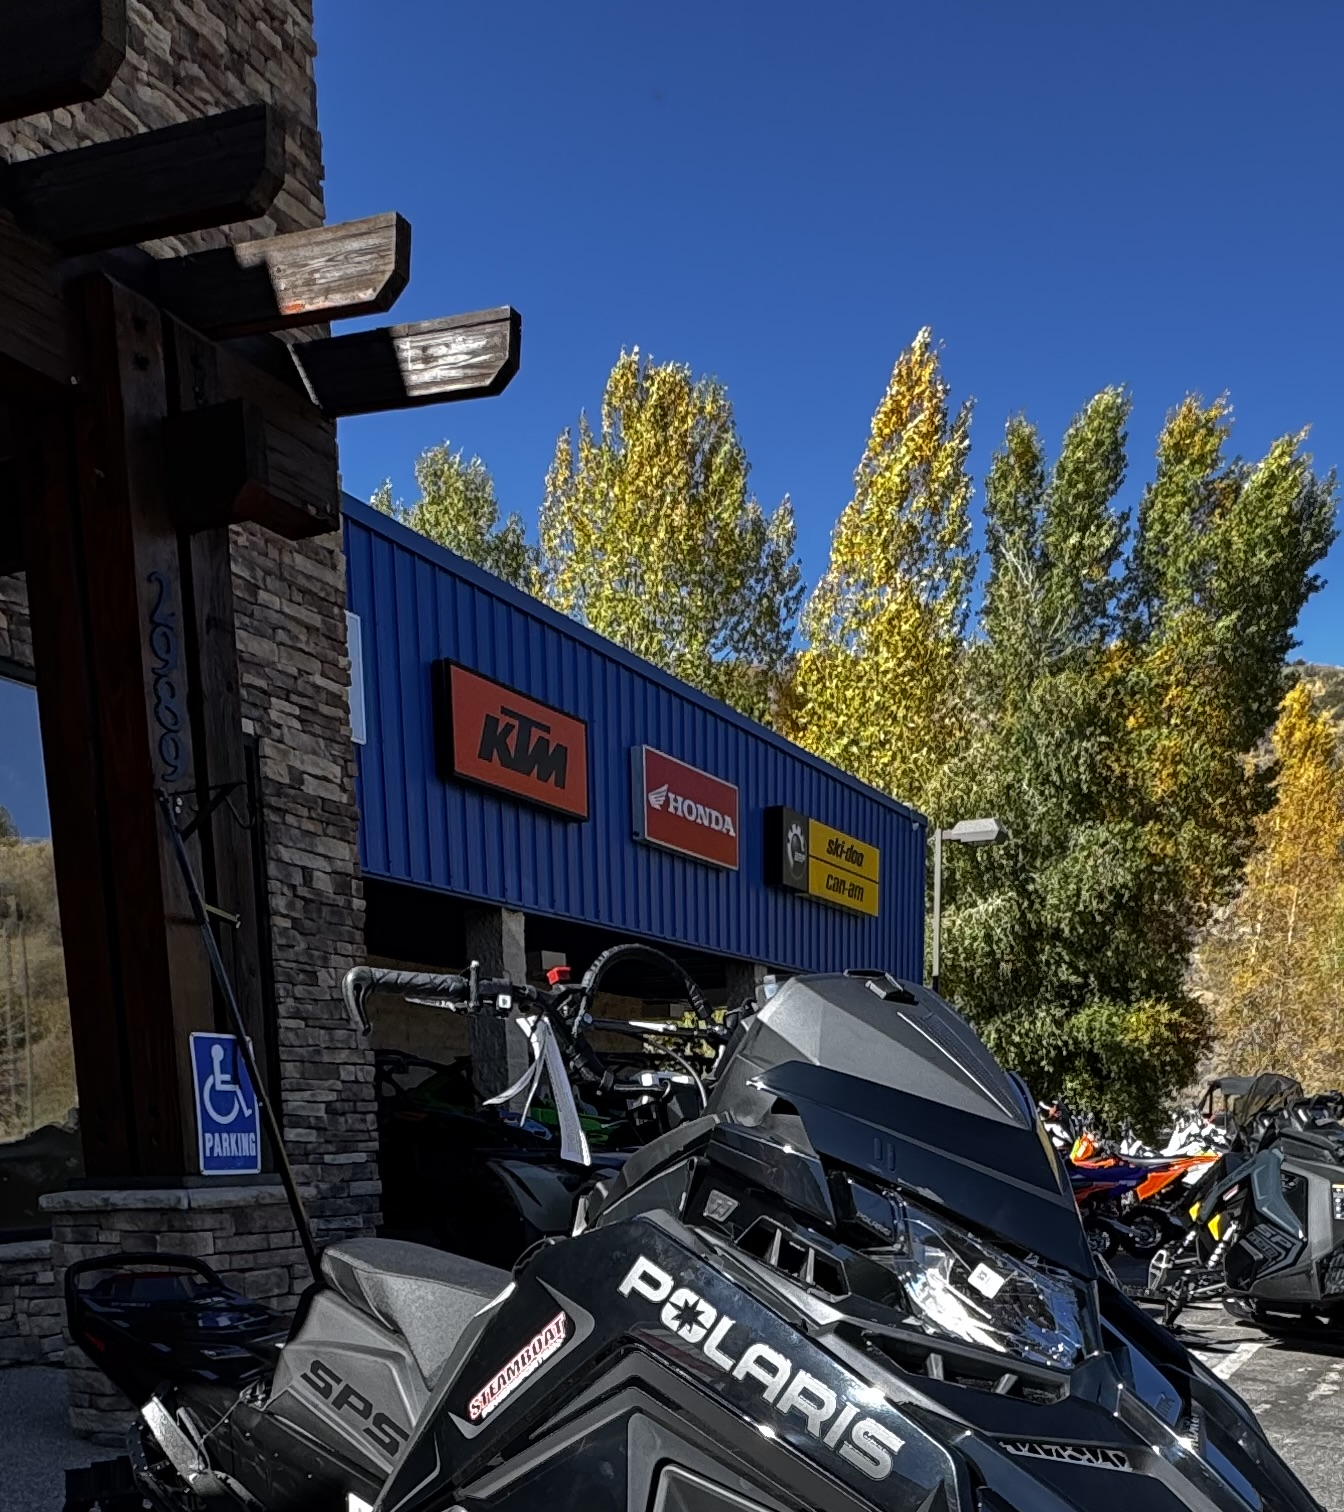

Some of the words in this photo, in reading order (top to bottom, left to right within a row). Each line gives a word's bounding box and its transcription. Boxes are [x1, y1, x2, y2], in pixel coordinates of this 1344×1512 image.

[477, 705, 568, 790] KTM
[667, 791, 737, 838] HONDA
[825, 834, 865, 868] ski-doo
[824, 873, 866, 904] can-am
[204, 1132, 258, 1160] PARKING
[467, 1313, 567, 1420] STEAMBOAT
[617, 1253, 906, 1482] POLARIS
[299, 1358, 410, 1458] SPS
